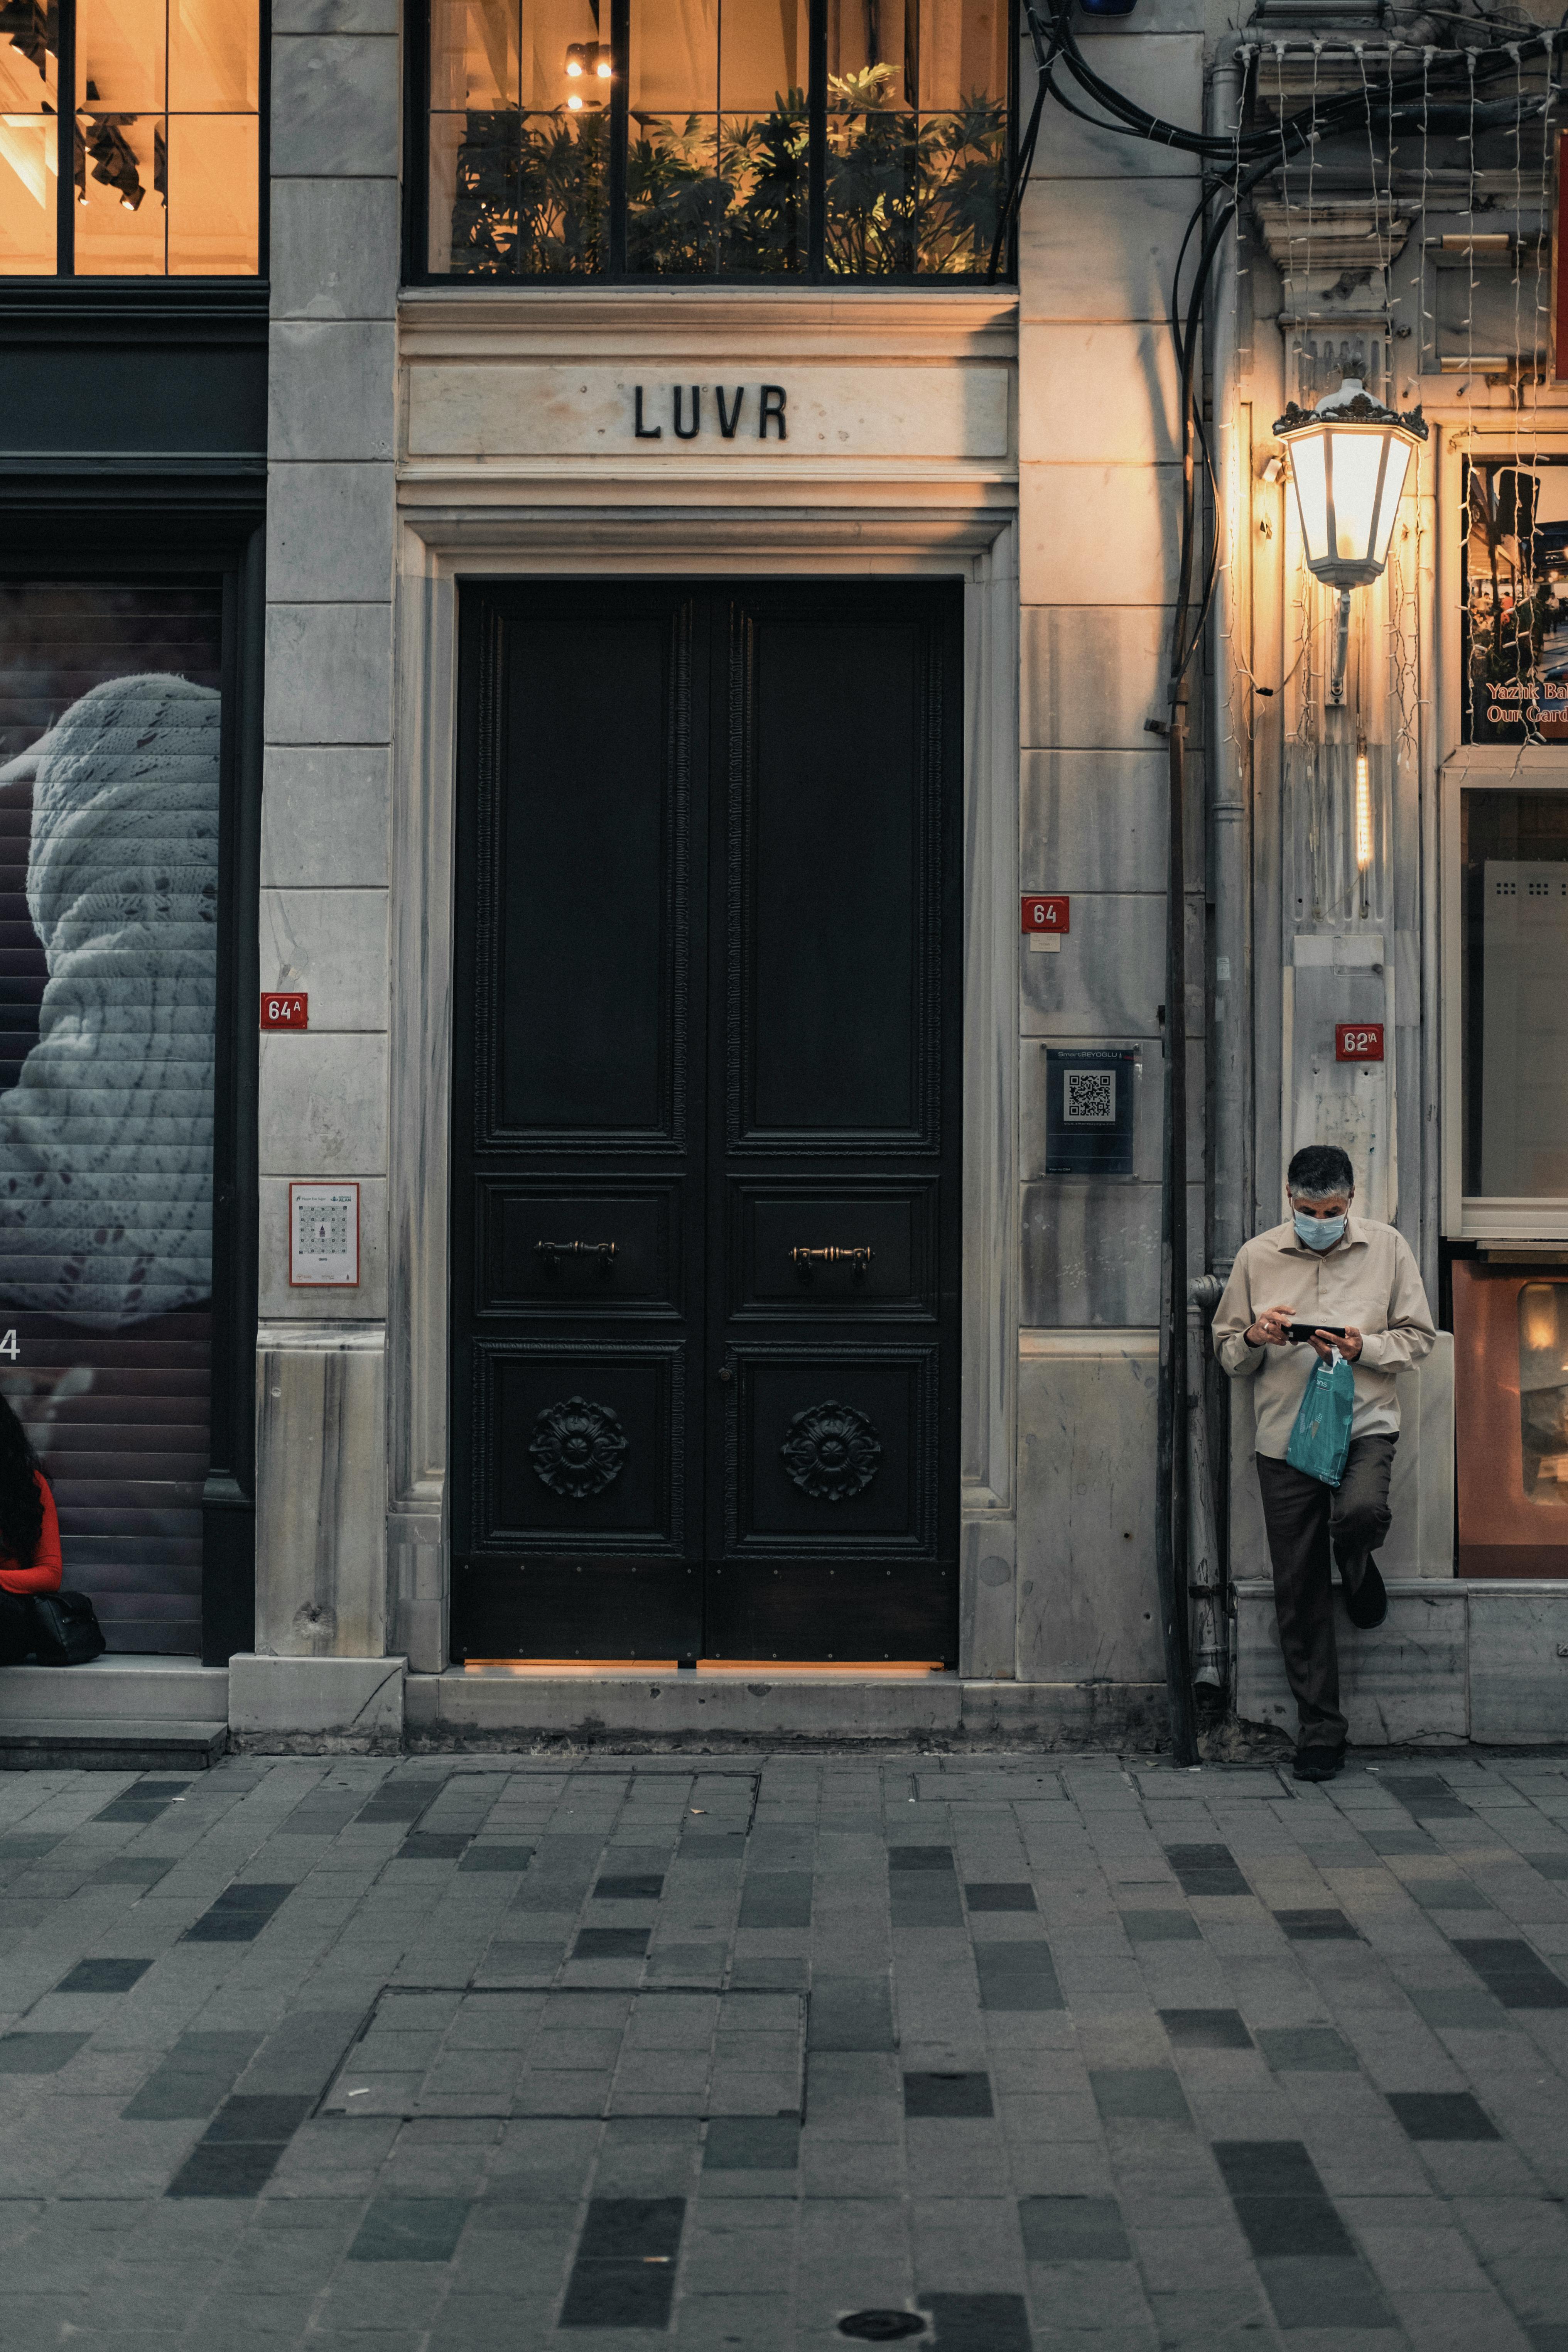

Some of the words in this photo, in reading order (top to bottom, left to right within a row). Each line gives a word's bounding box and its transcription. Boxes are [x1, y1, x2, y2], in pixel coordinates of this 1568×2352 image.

[635, 385, 787, 440] LUVR
[1487, 705, 1522, 723] Our
[1034, 905, 1056, 924] 64
[0, 1329, 20, 1360] 4
